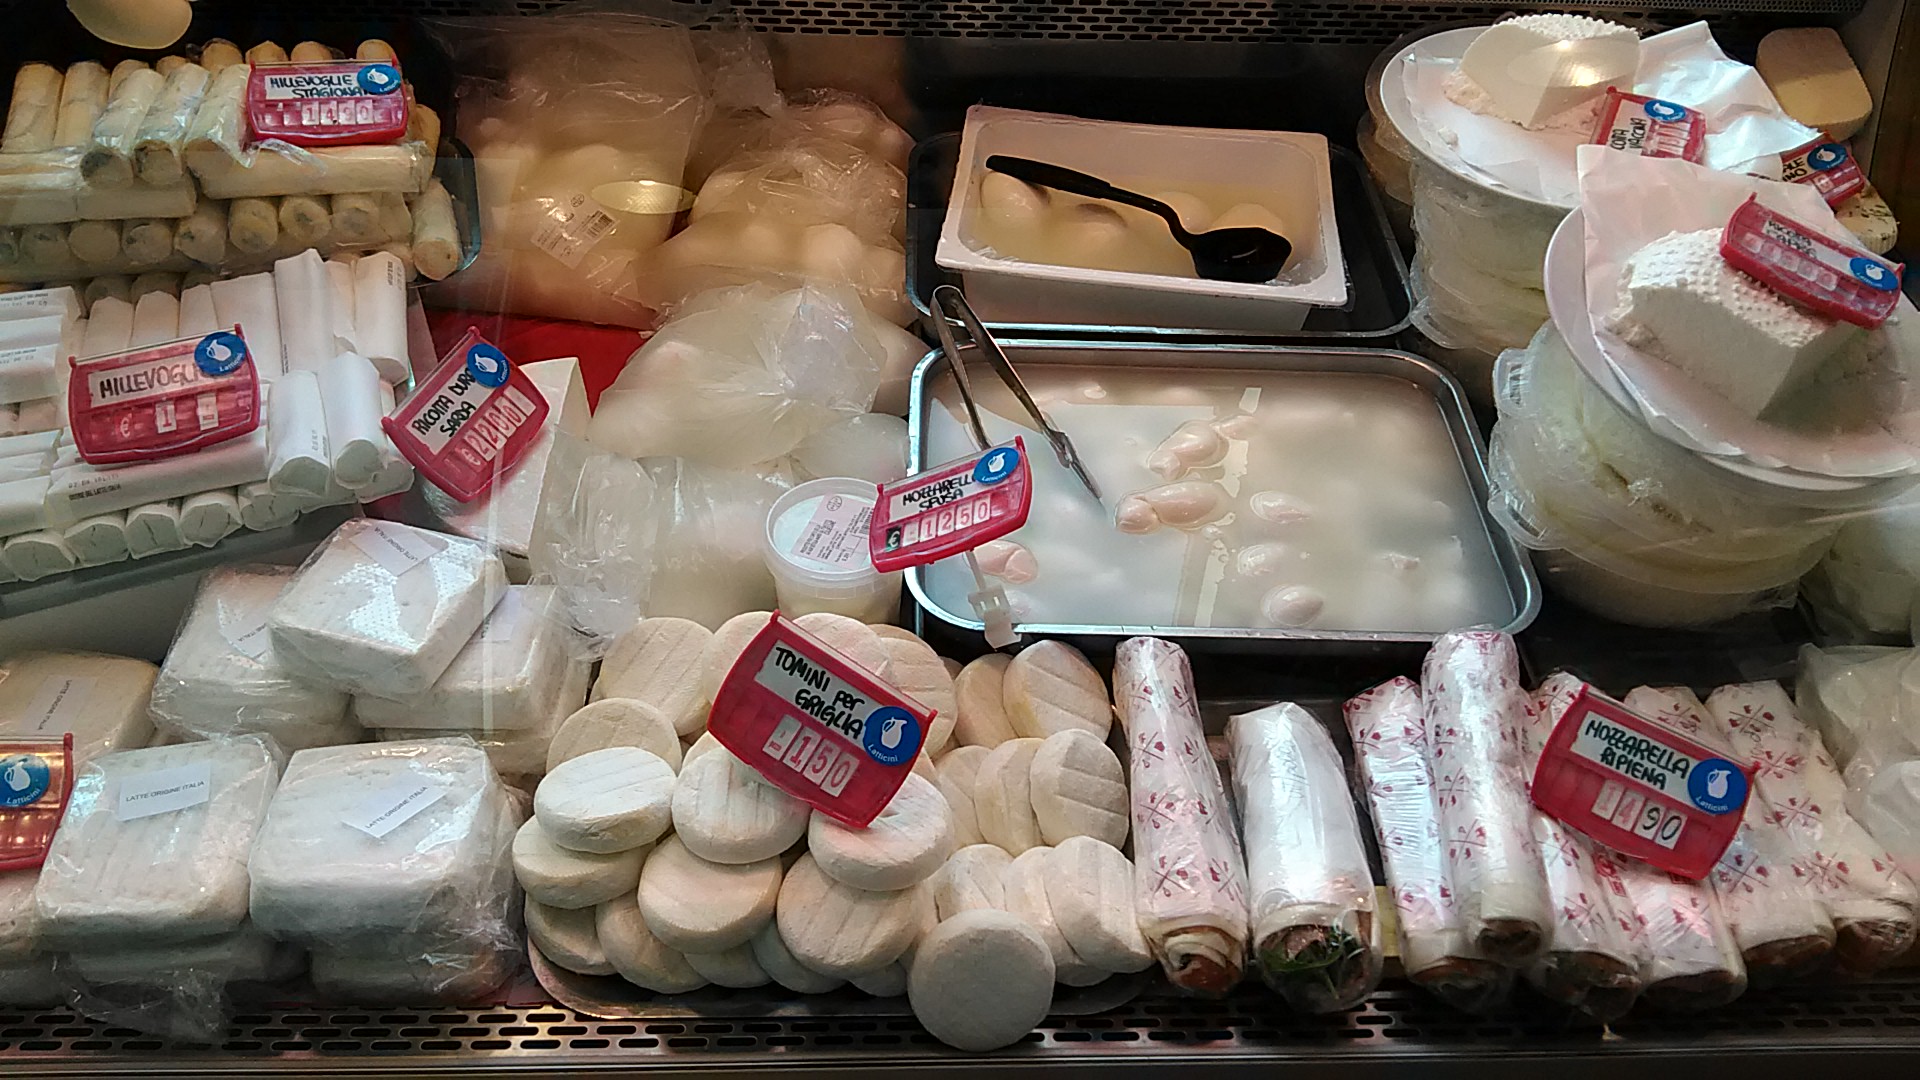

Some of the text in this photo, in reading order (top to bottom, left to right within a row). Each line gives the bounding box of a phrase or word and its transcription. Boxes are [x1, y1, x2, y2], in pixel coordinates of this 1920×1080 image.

[1782, 157, 1805, 173] ALE
[1782, 168, 1808, 182] INO
[99, 363, 202, 399] MILLEVOGLI
[439, 401, 477, 438] SARDA
[902, 474, 977, 507] MOZZARELL
[775, 647, 831, 692] TOMINI
[795, 689, 864, 740] GRIGLIA
[867, 743, 899, 763] Latticini
[1584, 719, 1691, 780] MOZZARELLA
[1600, 746, 1667, 790] RIPIENA
[6, 787, 41, 805] Latticini
[126, 780, 205, 803] LATTE ORIGINE ITALIA
[365, 786, 428, 829] LATTE ORIGINE ITALIA
